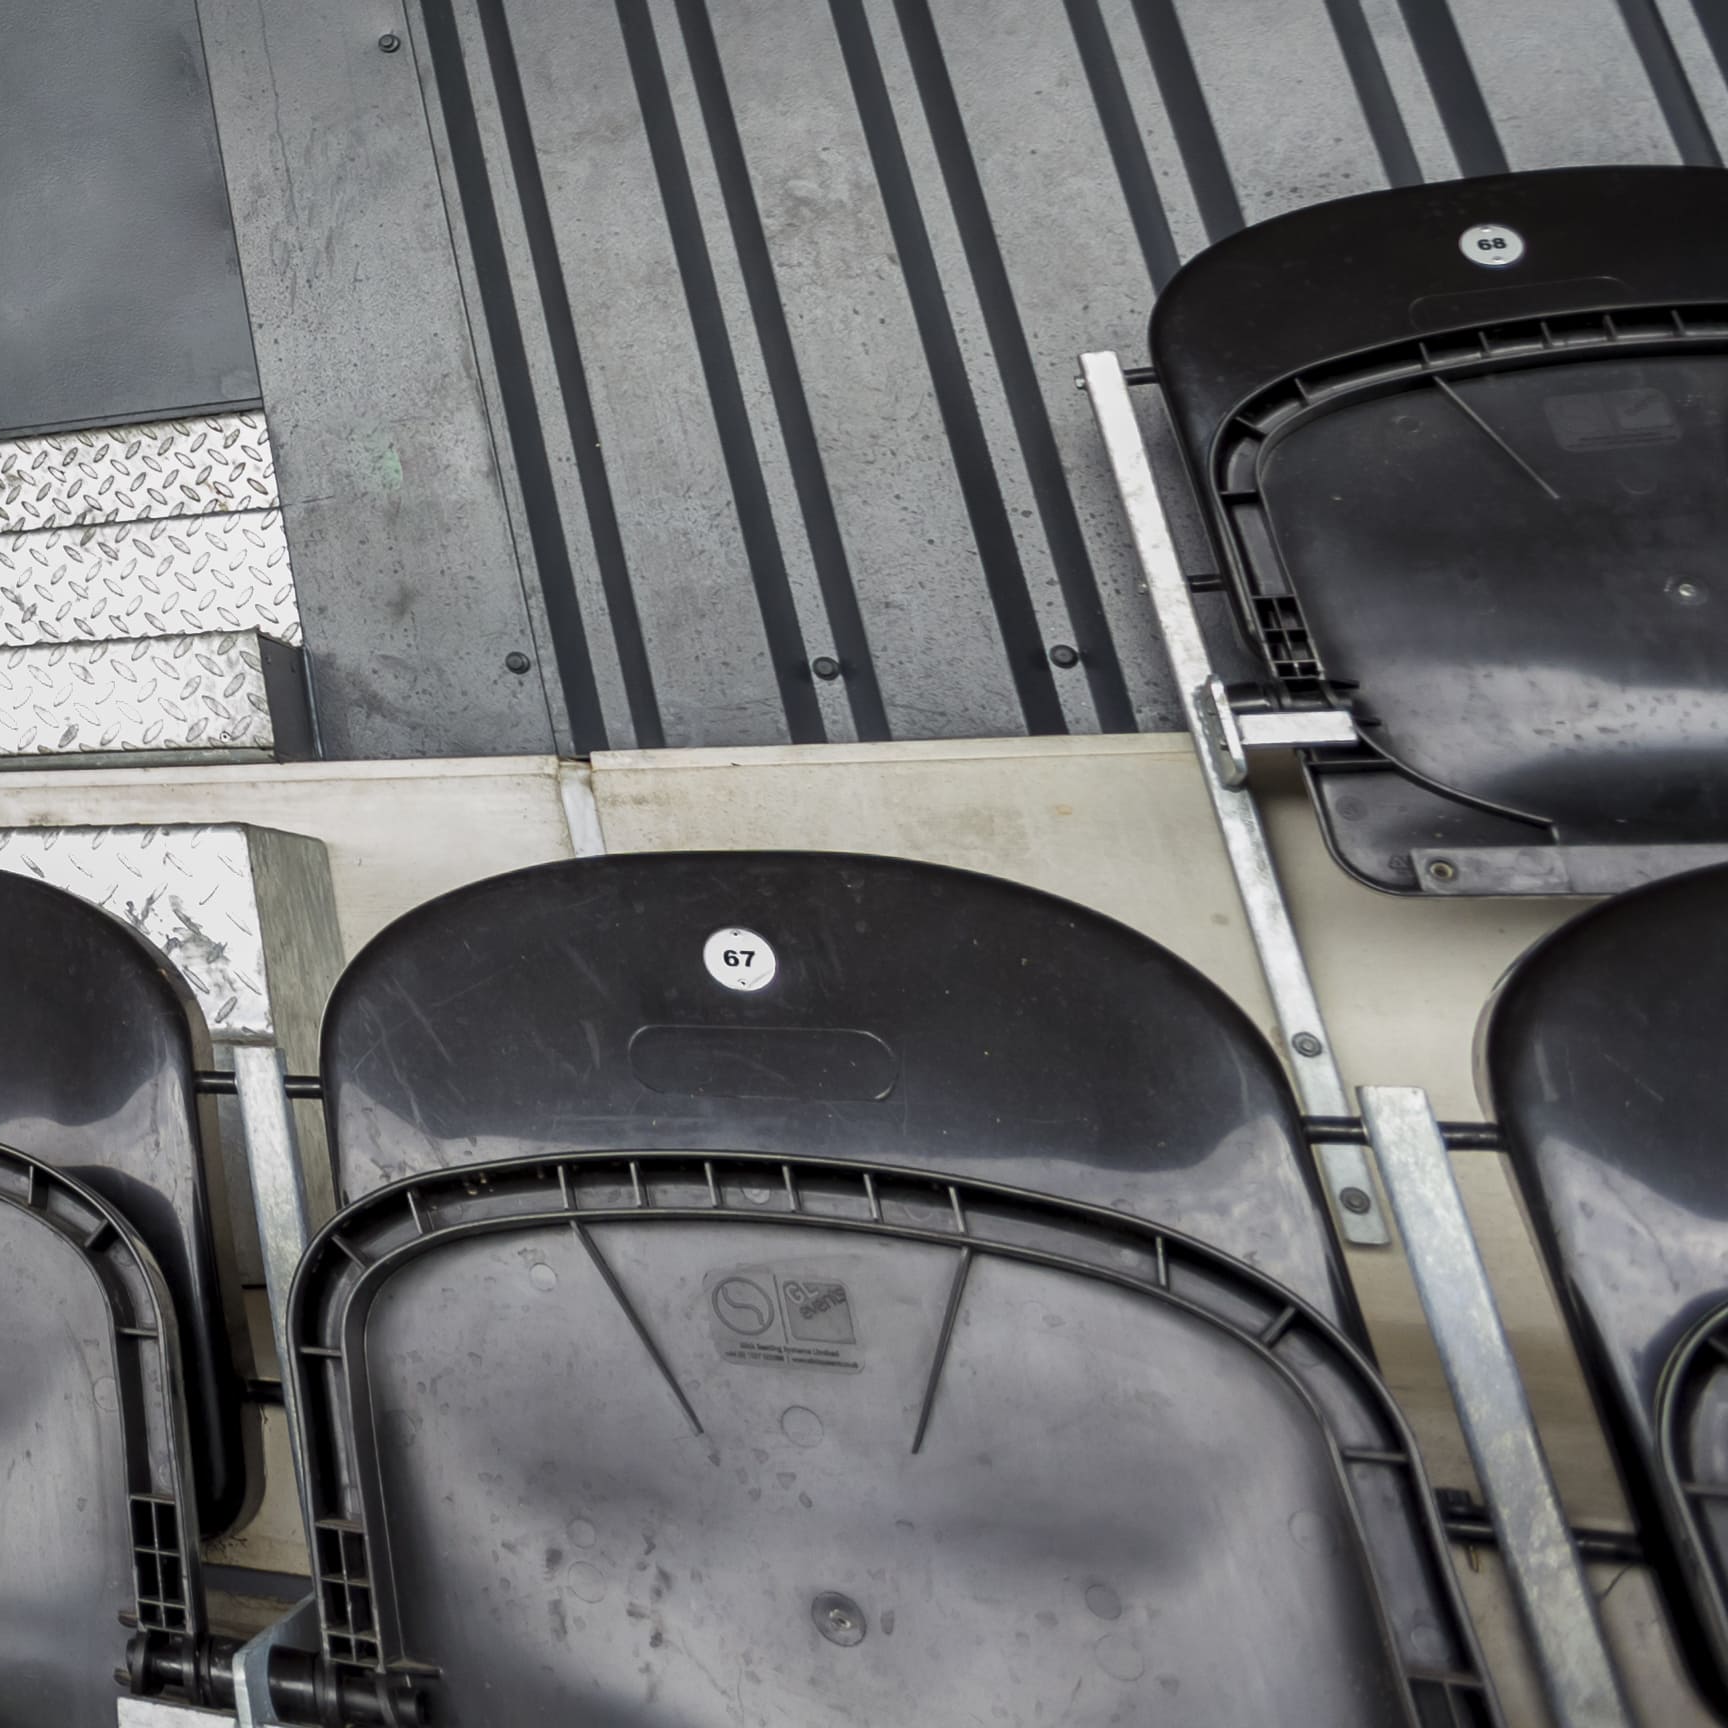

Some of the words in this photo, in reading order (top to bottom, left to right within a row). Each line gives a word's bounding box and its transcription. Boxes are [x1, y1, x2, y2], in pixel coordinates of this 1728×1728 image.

[1477, 237, 1507, 251] 68
[723, 949, 756, 968] 67
[784, 1280, 819, 1305] GL
[799, 1287, 847, 1320] events
